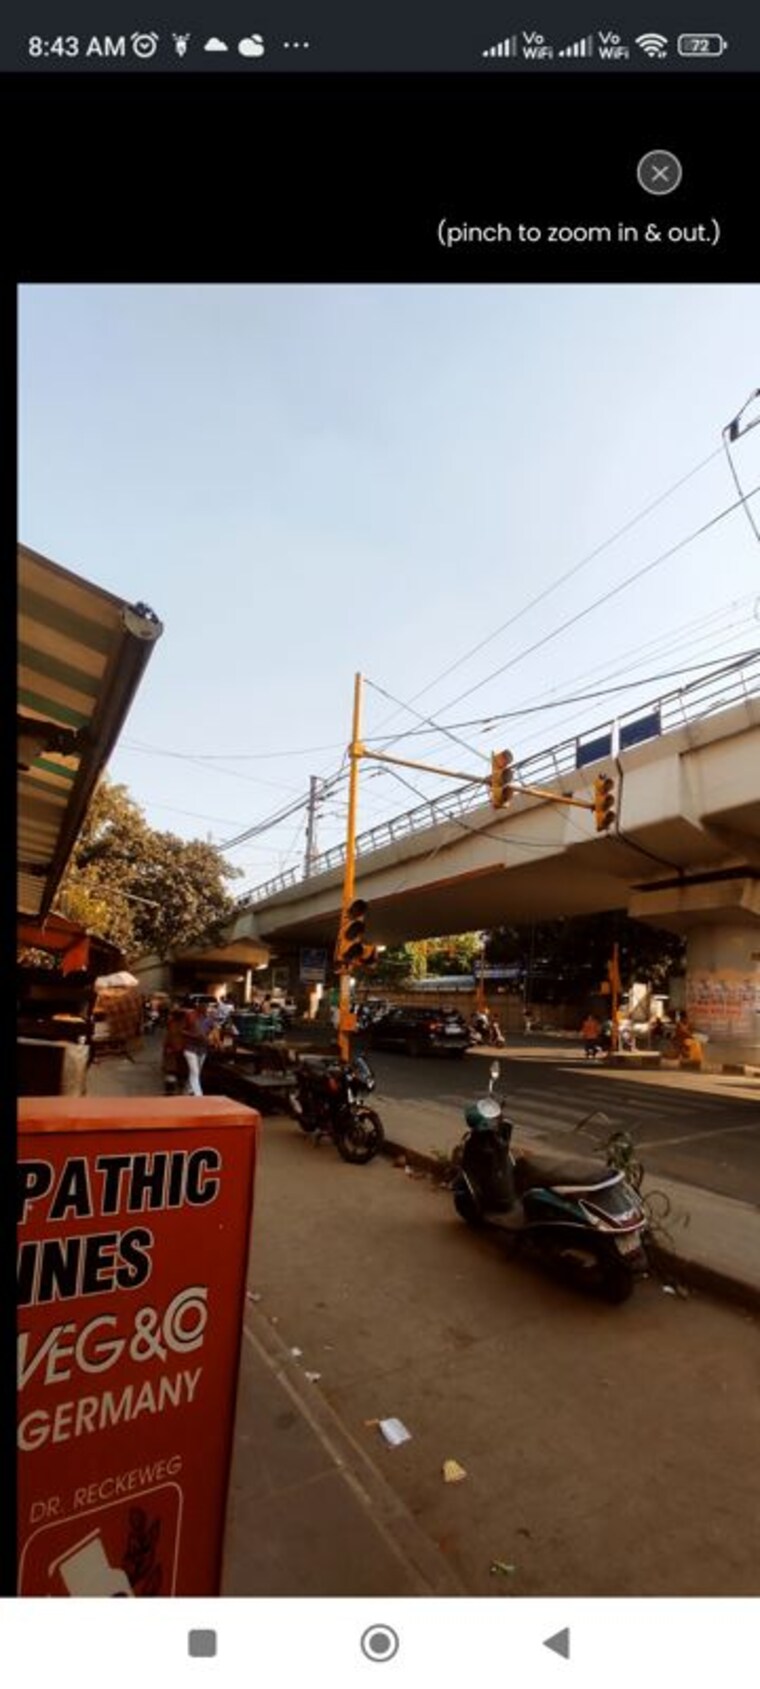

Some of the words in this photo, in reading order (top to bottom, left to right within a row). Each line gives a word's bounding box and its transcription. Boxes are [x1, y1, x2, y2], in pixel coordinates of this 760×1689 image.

[17, 1147, 220, 1225] PATHIC
[17, 1226, 154, 1309] INES
[17, 1367, 202, 1451] GERMANY
[73, 1455, 183, 1509] RECKEWEG
